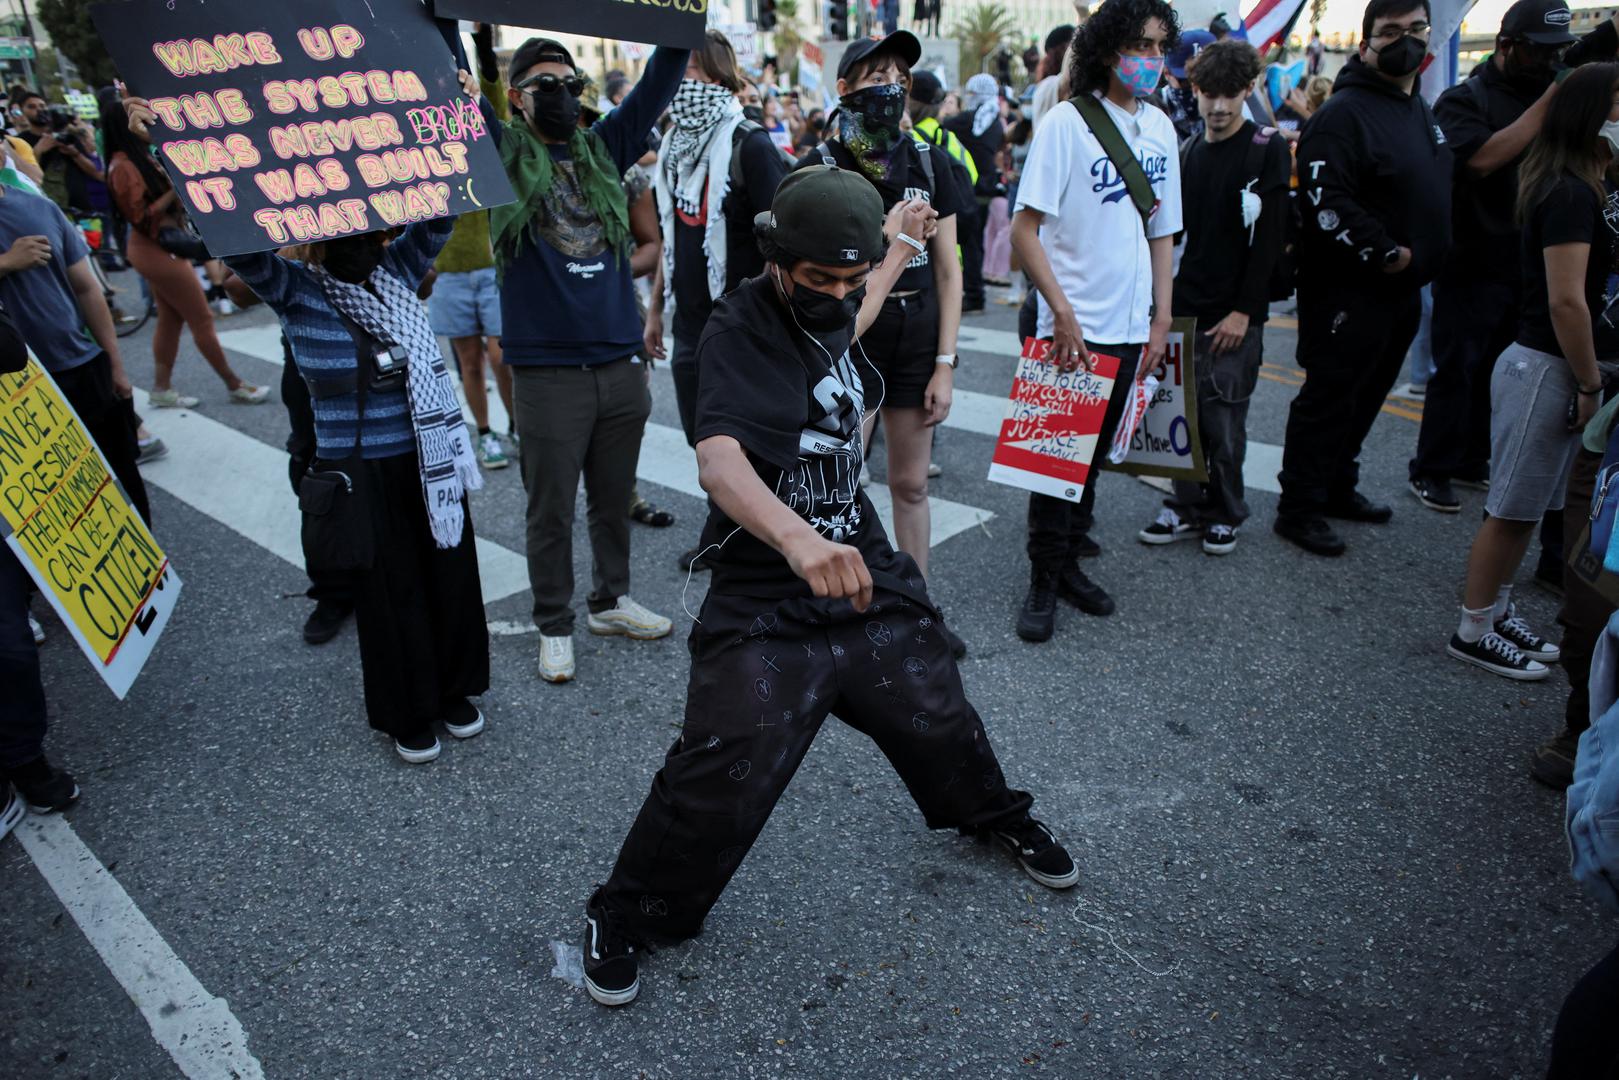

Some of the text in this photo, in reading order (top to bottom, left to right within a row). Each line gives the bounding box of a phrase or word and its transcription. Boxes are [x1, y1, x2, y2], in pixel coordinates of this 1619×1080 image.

[152, 23, 365, 78] WAKE UP
[150, 69, 428, 131] THE SYSTEM
[162, 132, 262, 176] WAS
[268, 112, 404, 160] NEVER
[185, 141, 469, 213] IT WAS BUILT
[253, 198, 369, 243] THAT
[368, 181, 451, 226] WAY
[35, 385, 64, 427] A
[1017, 380, 1040, 399] MY
[0, 416, 27, 486] AN
[13, 396, 52, 446] BE
[1144, 415, 1173, 453] have
[4, 418, 87, 523] PRESIDENT
[48, 494, 121, 592] CAN BE A
[79, 515, 160, 641] CITIZEN
